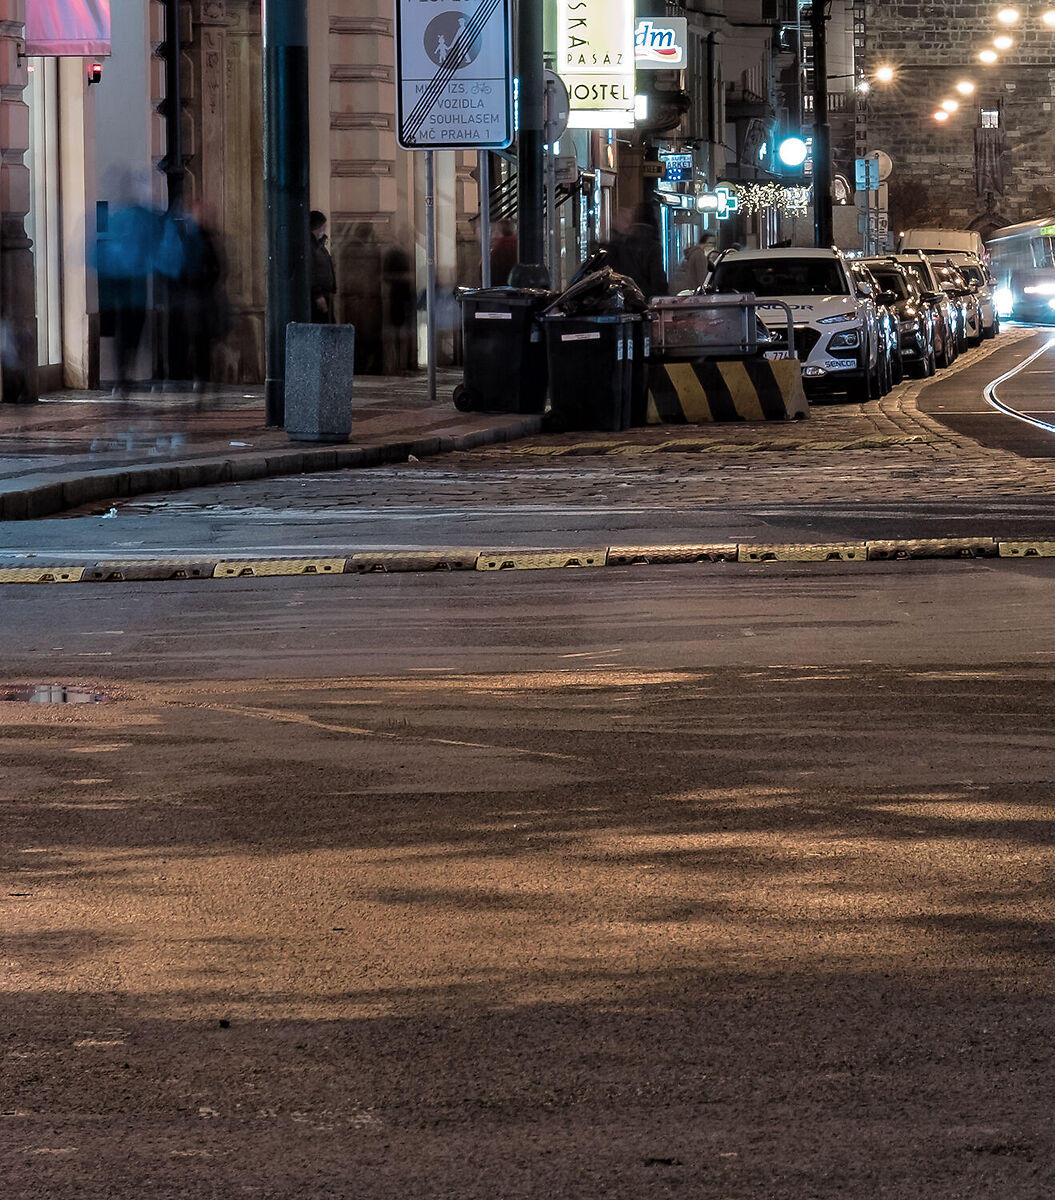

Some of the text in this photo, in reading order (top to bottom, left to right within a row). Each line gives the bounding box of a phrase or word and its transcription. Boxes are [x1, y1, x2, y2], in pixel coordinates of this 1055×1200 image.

[635, 24, 674, 47] dm
[437, 99, 485, 109] VOZIDLA
[429, 114, 500, 125] SOUHLASEM
[419, 128, 491, 140] MČ PRAHA 1
[666, 161, 692, 169] ARKET
[824, 360, 857, 369] SENCOR
